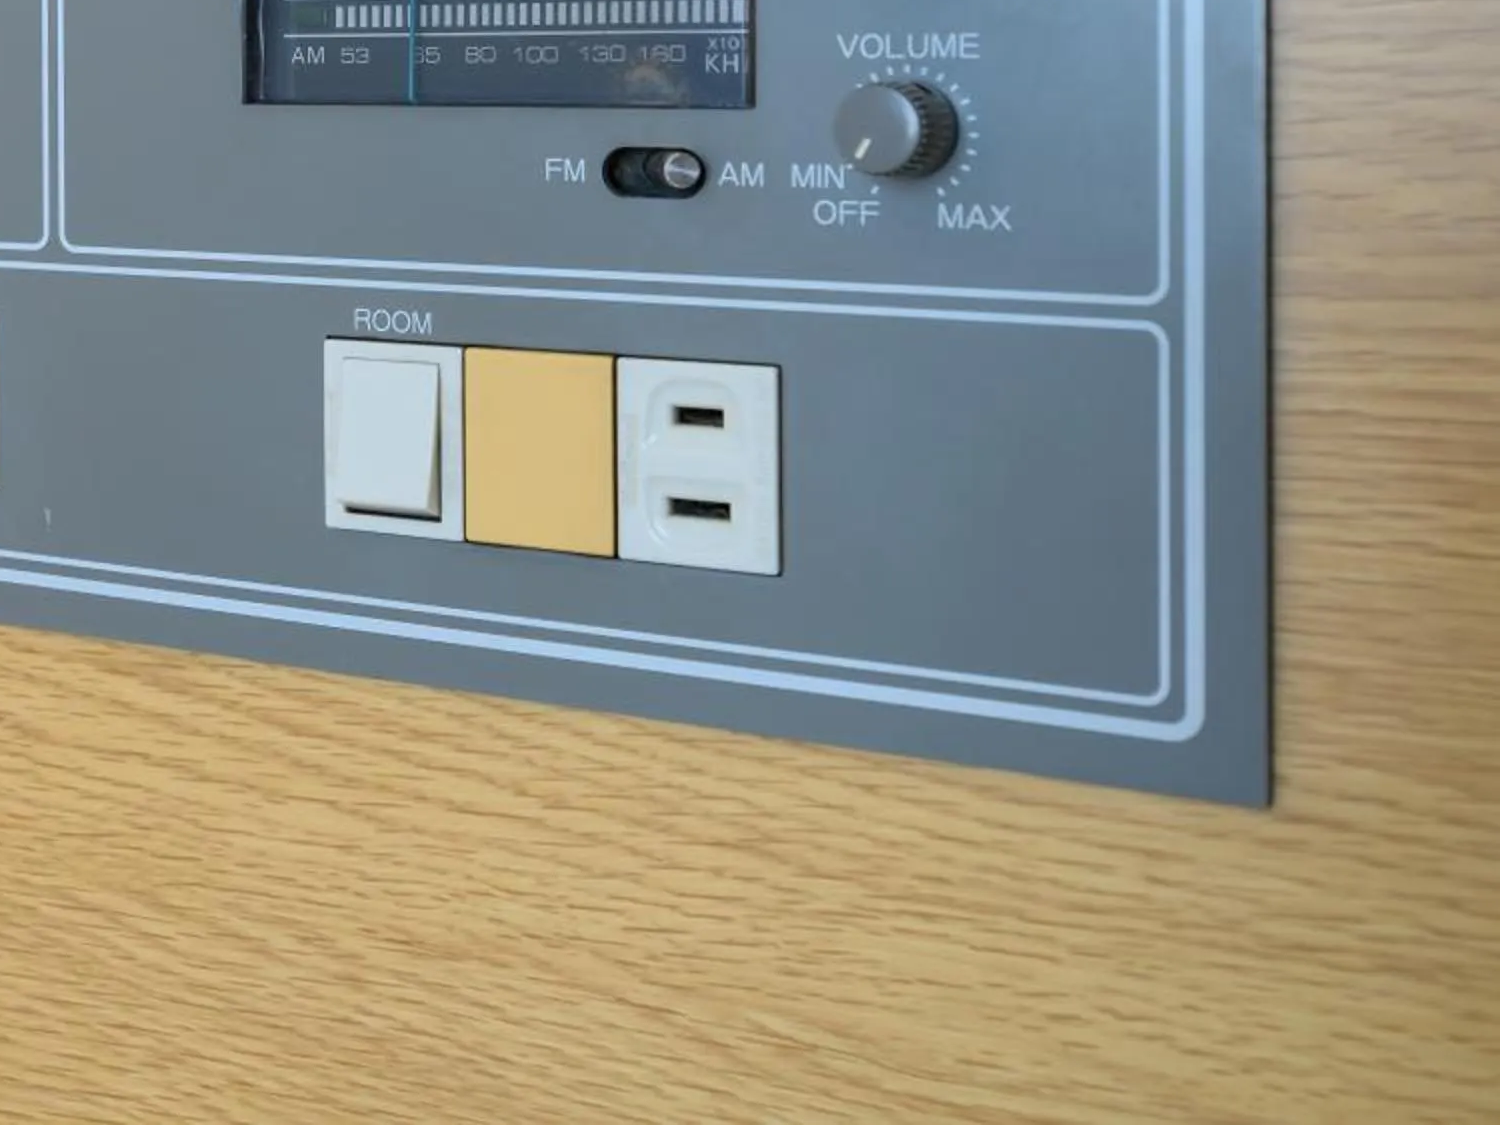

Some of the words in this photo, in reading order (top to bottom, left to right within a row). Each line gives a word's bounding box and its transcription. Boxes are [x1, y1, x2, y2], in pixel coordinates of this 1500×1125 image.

[291, 46, 325, 64] AM
[340, 47, 370, 64] 53
[465, 46, 497, 64] 80
[512, 46, 559, 64] 100
[578, 44, 626, 63] 130
[639, 44, 686, 63] 160
[836, 32, 980, 60] VOLUME
[545, 158, 586, 183] FM
[718, 162, 765, 188] AM
[791, 163, 846, 190] MIN
[813, 200, 881, 226] OFF
[937, 204, 1012, 231] MAX
[353, 308, 432, 335] ROOM
